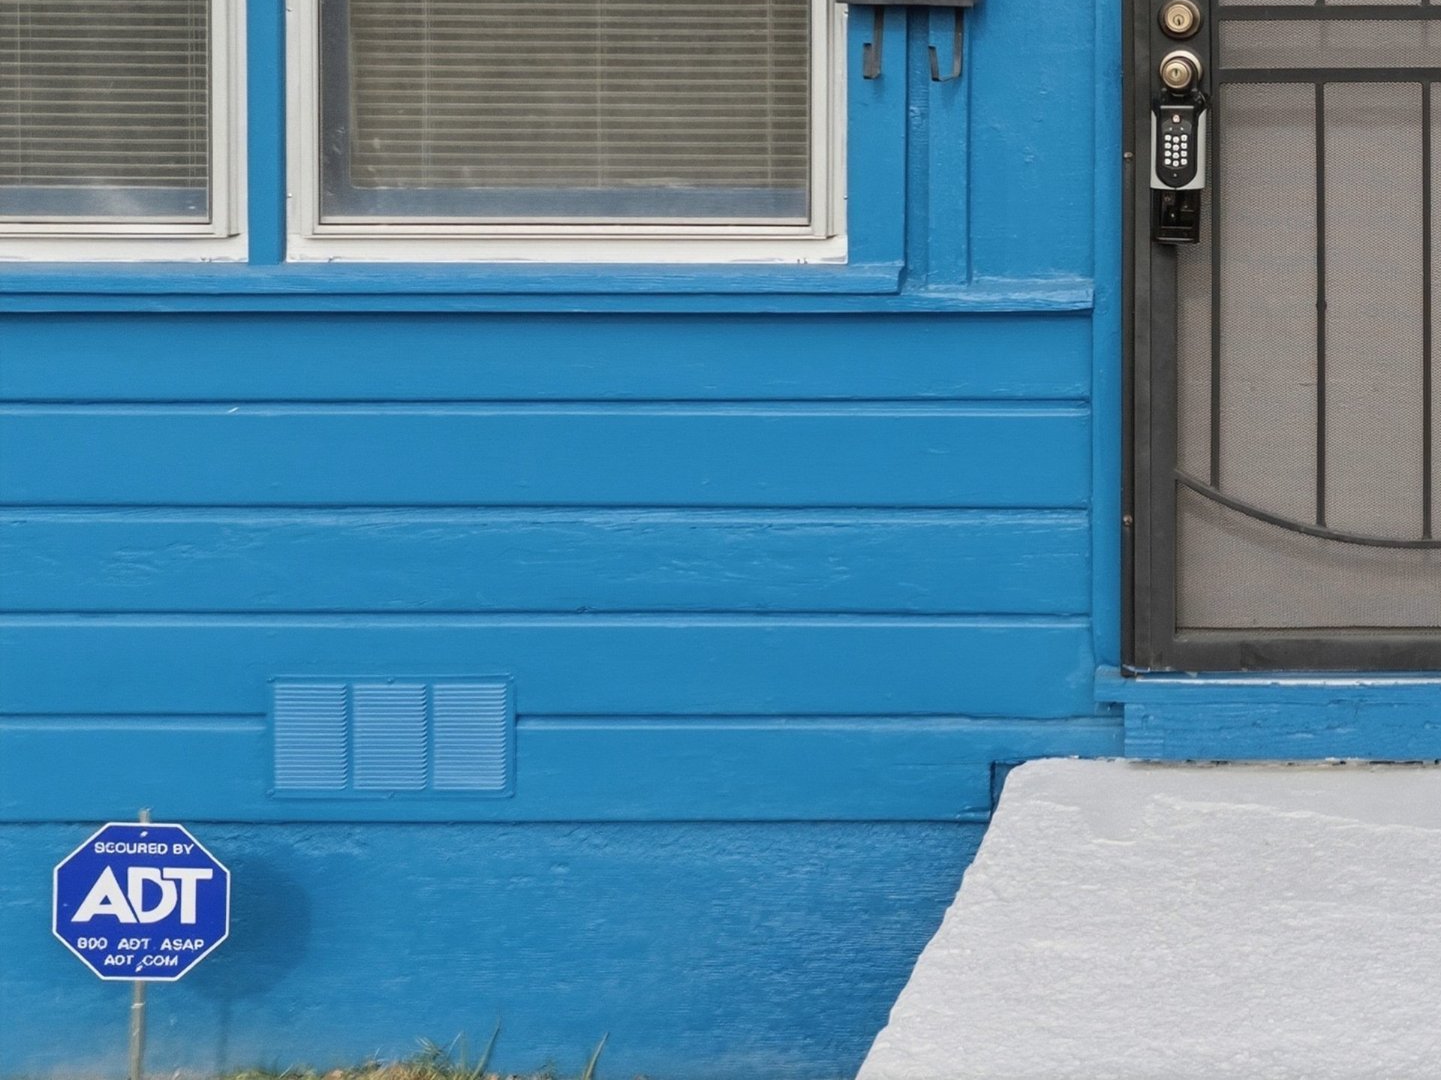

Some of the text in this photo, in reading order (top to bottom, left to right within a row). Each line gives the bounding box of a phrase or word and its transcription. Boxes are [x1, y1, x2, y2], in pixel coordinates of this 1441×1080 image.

[172, 843, 195, 855] BY
[71, 865, 213, 924] ADT
[160, 938, 205, 951] ASAP
